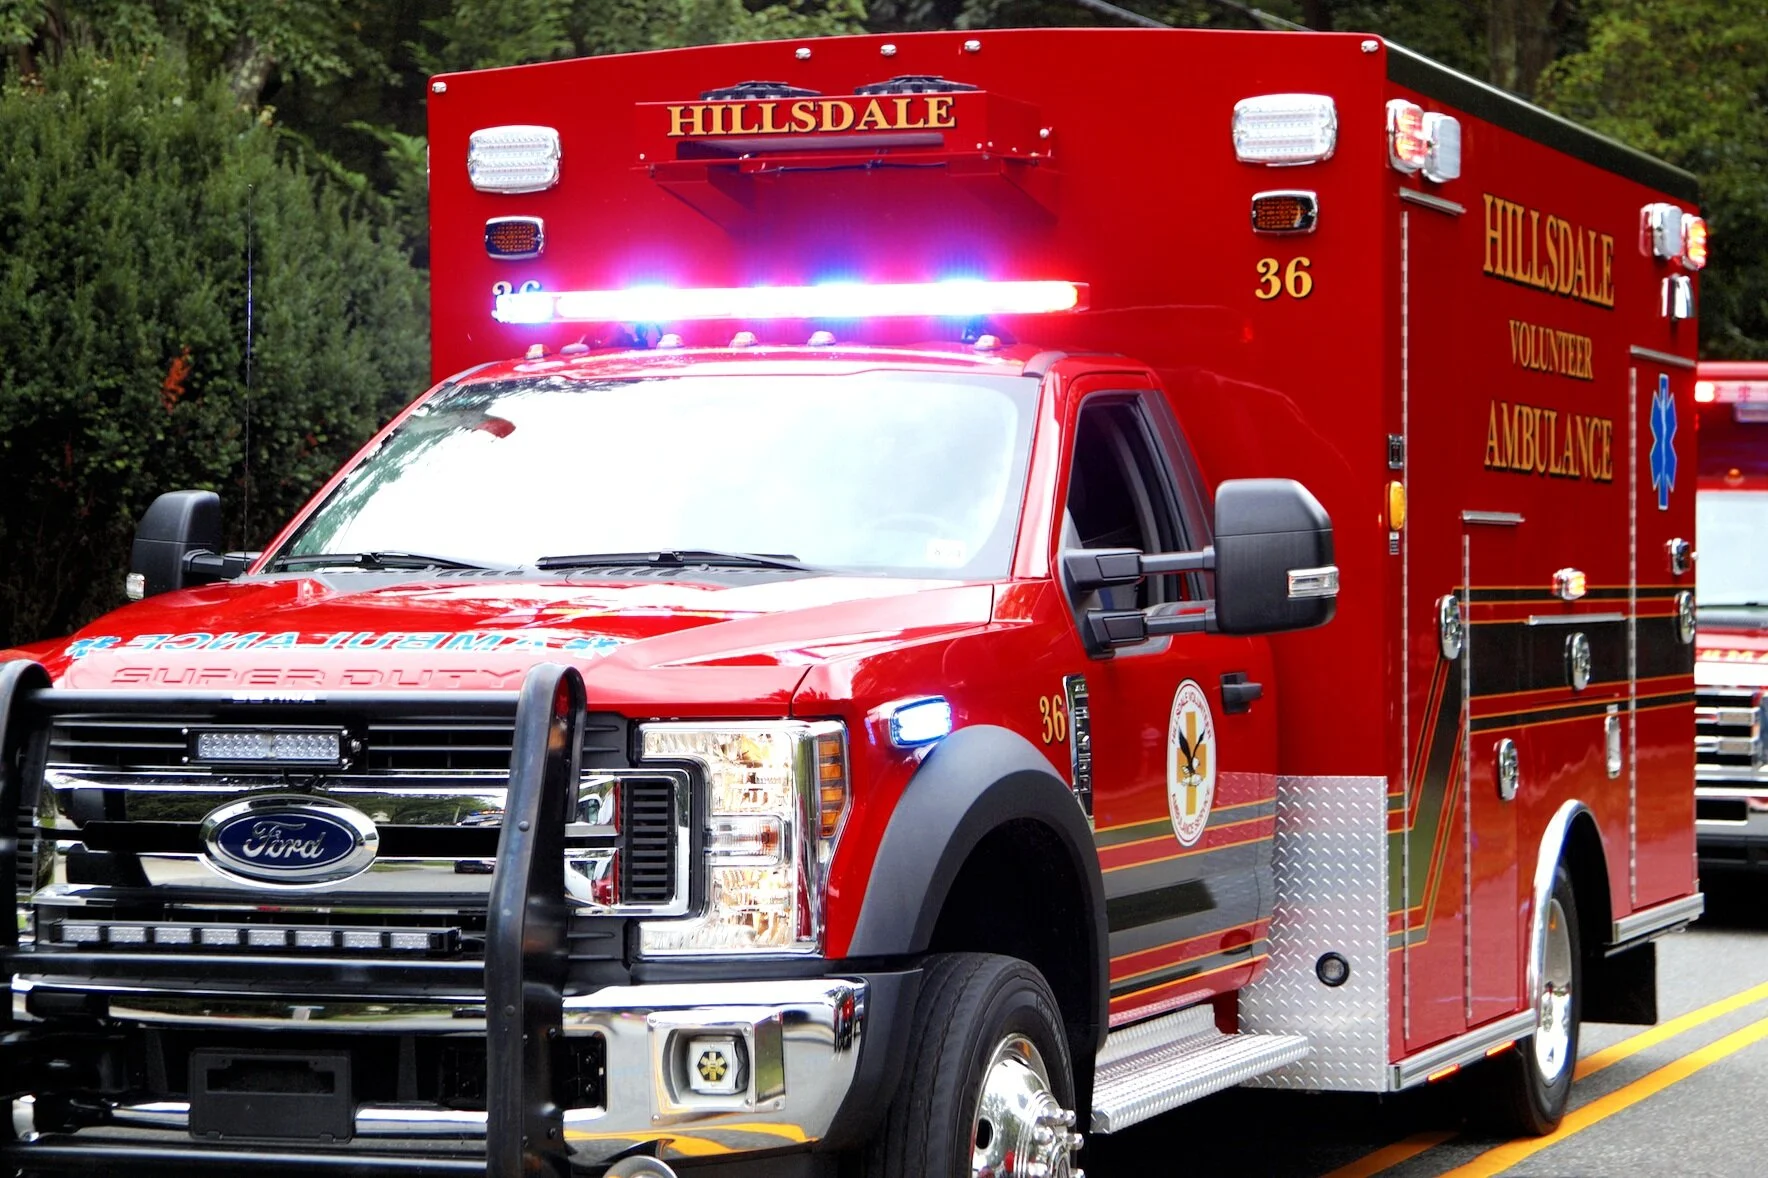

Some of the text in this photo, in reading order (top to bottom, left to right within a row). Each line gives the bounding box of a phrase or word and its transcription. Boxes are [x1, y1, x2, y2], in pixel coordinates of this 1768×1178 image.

[667, 97, 957, 137] HILLSDALE
[1483, 193, 1614, 308] HILLSDALE
[1255, 256, 1313, 300] 36
[1509, 319, 1594, 380] VOLUNTEER
[1484, 399, 1613, 482] AMBULANCE
[110, 667, 522, 689] SUPER DUTY
[1039, 694, 1067, 744] 36
[242, 820, 326, 859] Ford
